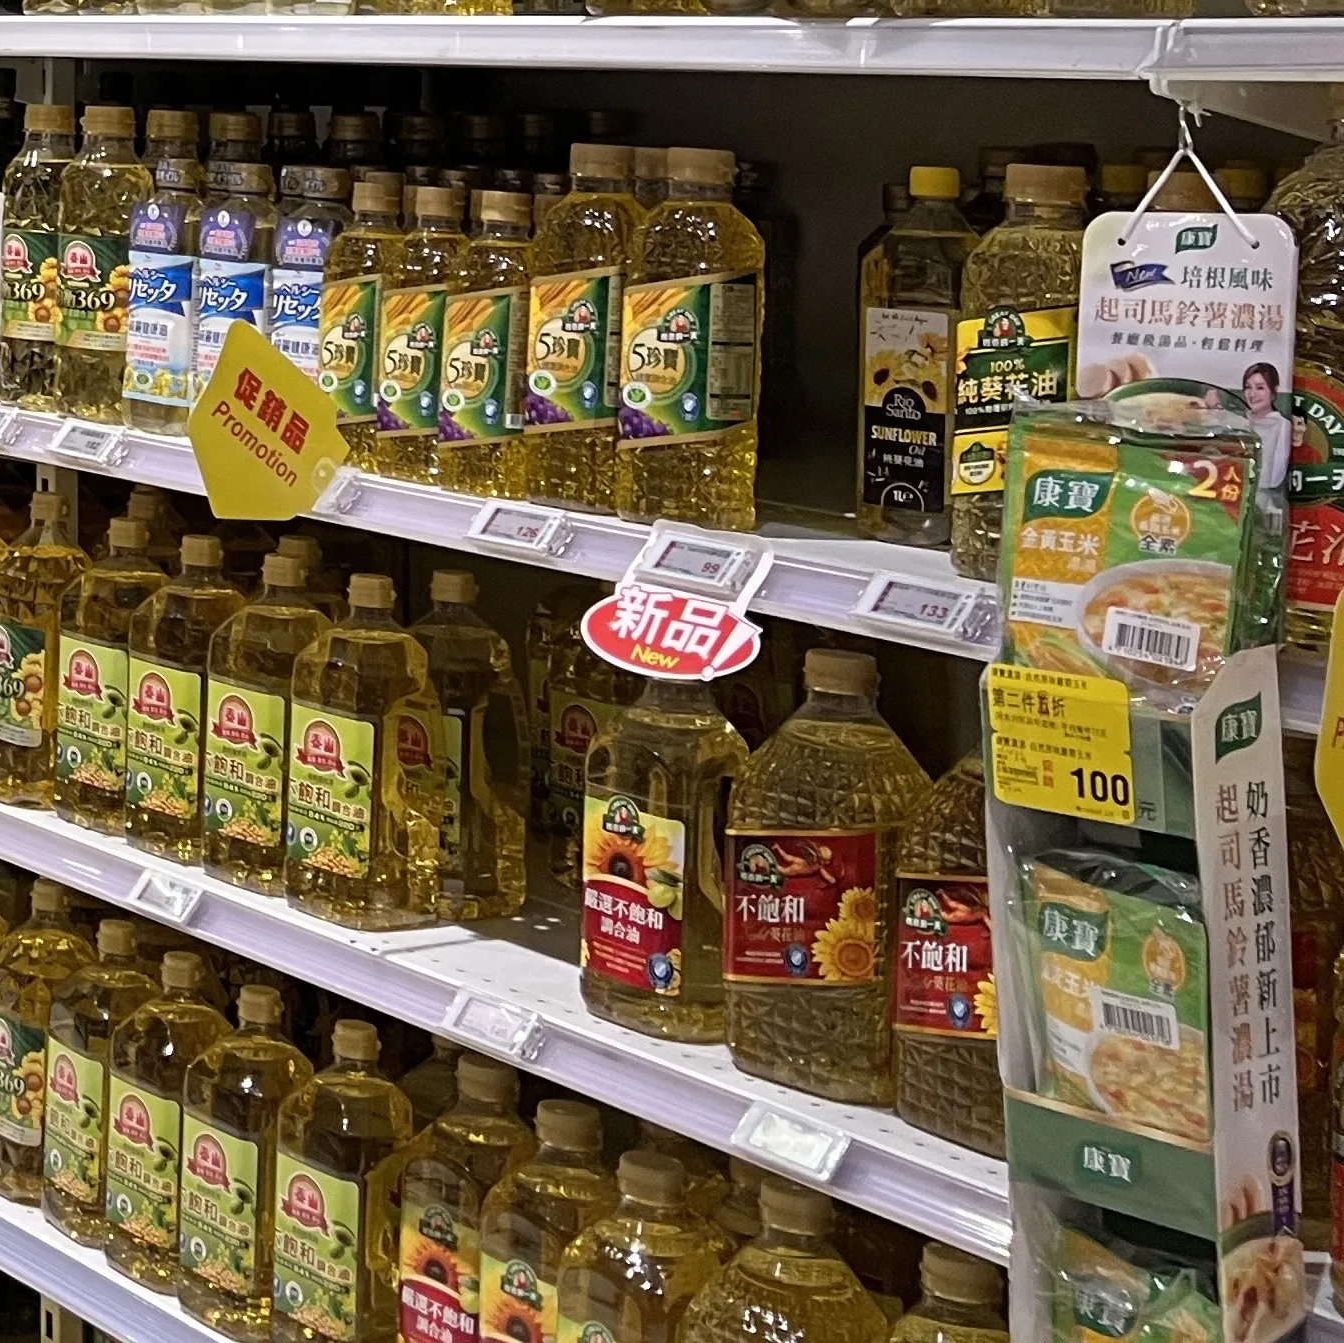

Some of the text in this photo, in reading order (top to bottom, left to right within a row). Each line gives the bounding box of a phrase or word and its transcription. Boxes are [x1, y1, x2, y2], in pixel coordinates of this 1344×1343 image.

[1126, 268, 1157, 283] New
[1181, 266, 1273, 291] 培根風味
[1094, 296, 1284, 333] 起司馬鈴薯濃湯
[990, 358, 1025, 373] 100%
[893, 394, 914, 409] Rio
[958, 369, 1058, 405] 純葵花油
[234, 367, 311, 452] 促銷品
[886, 406, 921, 421] Santo
[211, 402, 299, 489] Promotion
[871, 425, 937, 446] SUNFLOWER
[909, 445, 925, 456] Oil
[1188, 460, 1218, 498] 2
[1220, 467, 1240, 501] 人份
[1033, 476, 1100, 512] 康寶
[1021, 527, 1099, 556] 金黃玉米
[701, 562, 720, 574] 99
[919, 602, 949, 618] 133
[630, 644, 681, 669] New
[1221, 709, 1257, 742] 康寶
[310, 733, 335, 753] 泰山
[1070, 767, 1130, 806] 100
[1138, 800, 1157, 821] 元
[585, 887, 663, 930] 嚴選不飽和
[736, 894, 804, 923] 不飽和
[601, 916, 640, 944] 調合油
[1245, 780, 1281, 1105] 奶香濃郁新上市
[901, 940, 967, 973] 不飽和
[1213, 783, 1255, 1113] 起司馬鈴薯濃湯
